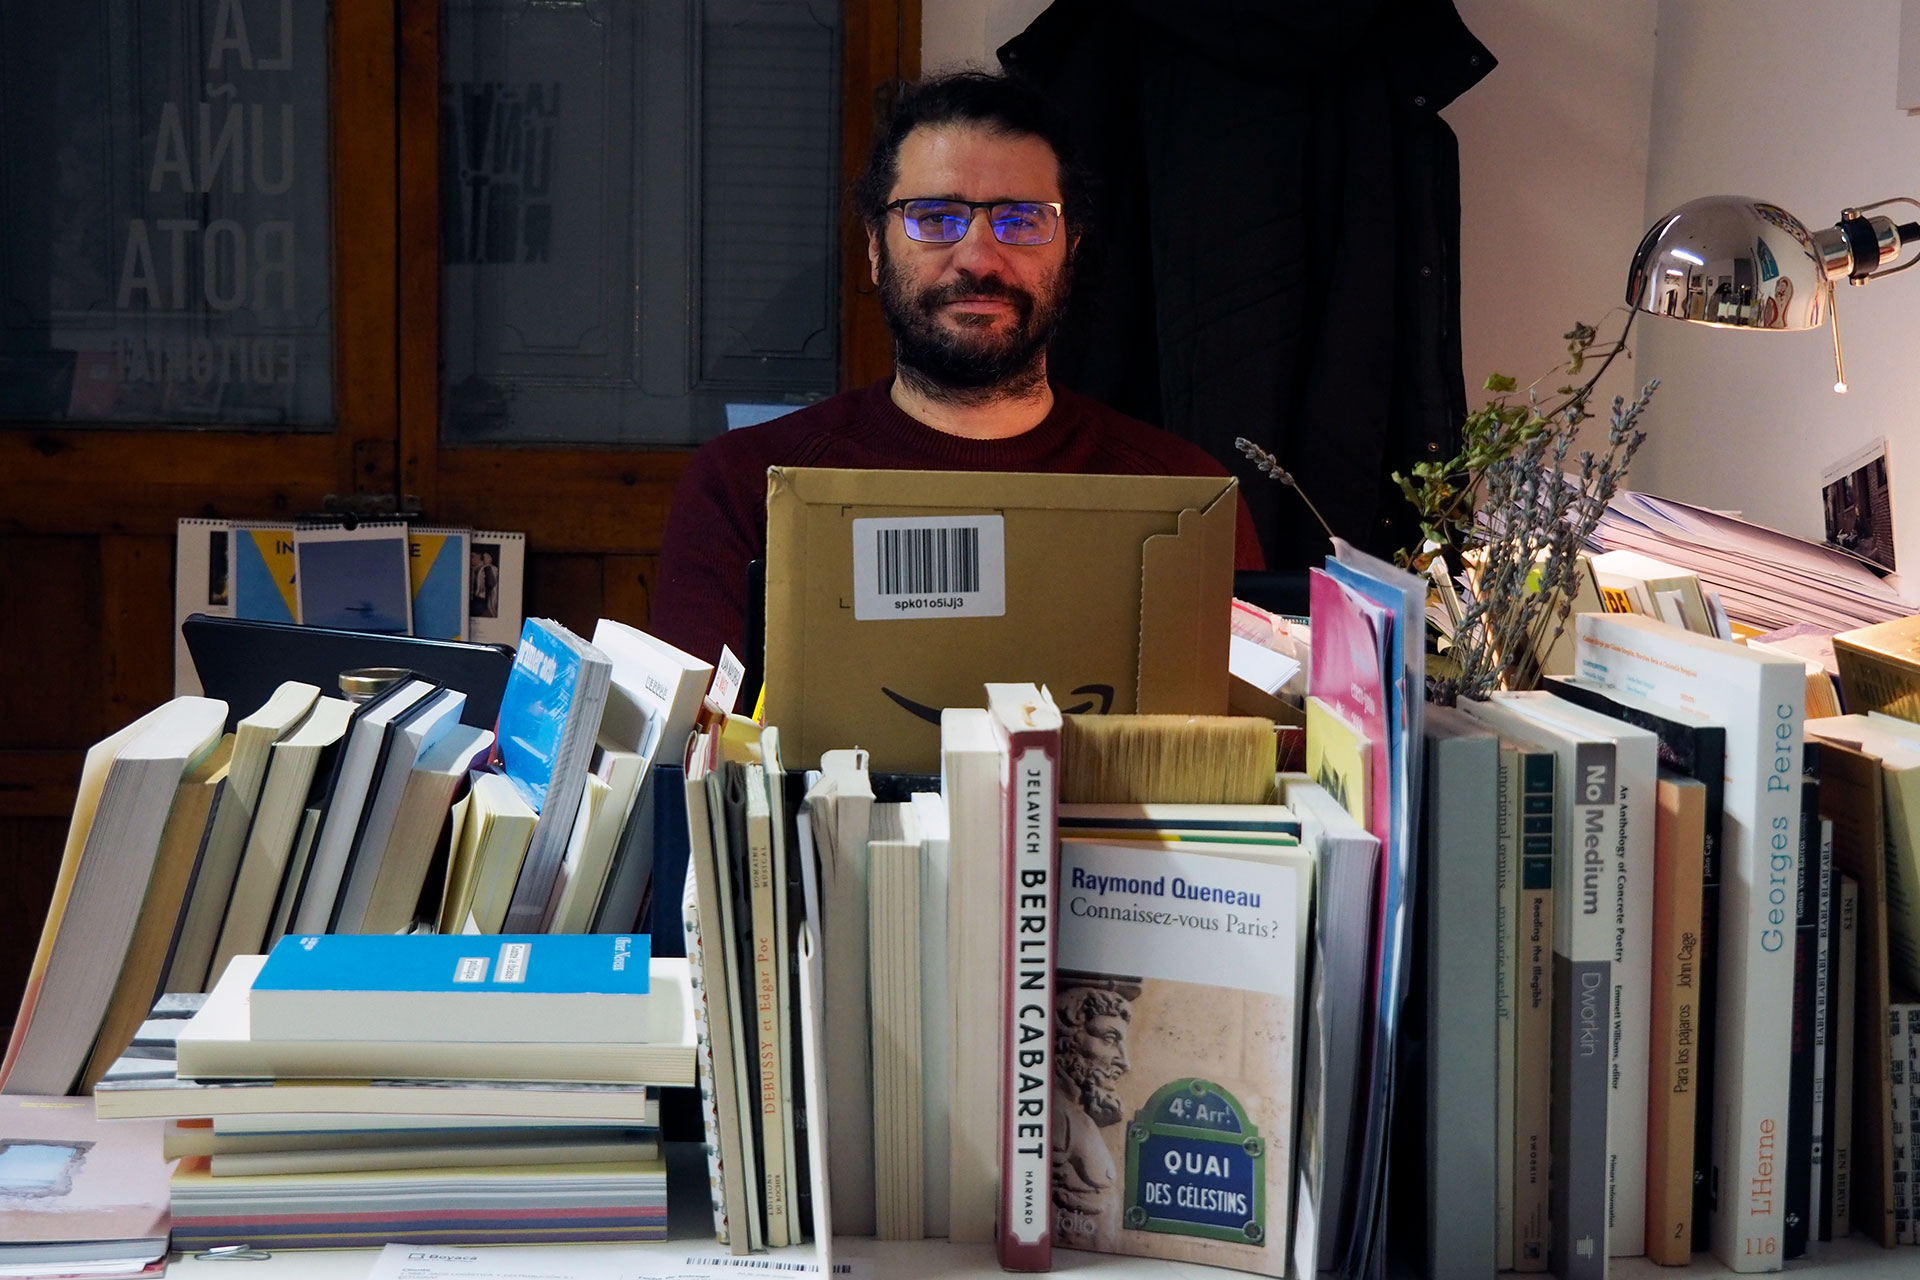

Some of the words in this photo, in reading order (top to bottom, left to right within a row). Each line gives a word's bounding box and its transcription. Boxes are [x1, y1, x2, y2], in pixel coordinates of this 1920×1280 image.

[1769, 703, 1793, 793] Perec
[1498, 765, 1511, 841] unoriginal
[1585, 765, 1606, 801] No
[1619, 785, 1629, 800] An
[1026, 769, 1041, 854] JELAVICH
[1615, 803, 1628, 859] Anthology
[1583, 809, 1605, 915] Medium
[1703, 834, 1714, 856] Cage
[751, 846, 761, 888] DOMAINE
[760, 845, 769, 888] MUSICAL
[1497, 844, 1509, 888] genius
[1618, 862, 1628, 873] of
[1703, 857, 1712, 878] John
[1761, 816, 1792, 953] Georges
[1821, 841, 1831, 897] BLABLABLA
[1072, 867, 1165, 898] Raymond
[1171, 875, 1261, 908] Queneau
[1616, 875, 1627, 924] Concrete
[1020, 870, 1047, 992] BERLIN
[1070, 898, 1221, 932] Connaissez-vous
[1531, 897, 1543, 942] Reading
[1819, 900, 1829, 939] BLABLA
[1843, 897, 1853, 930] NETS
[1497, 906, 1510, 967] marjorie
[1531, 945, 1542, 964] the
[1614, 927, 1626, 963] Poetry
[1677, 932, 1696, 961] Cage
[759, 969, 772, 1011] Edgar
[1497, 971, 1510, 1022] perloff
[1530, 965, 1543, 1009] Illegible
[1677, 963, 1693, 989] John
[1817, 949, 1827, 1005] BLABLABLA
[1579, 971, 1601, 1057] Dworkin
[1613, 984, 1623, 1019] Emmett
[762, 1014, 773, 1032] et
[1612, 1020, 1622, 1061] Williams,
[1815, 1007, 1825, 1046] BLABLA
[1674, 1037, 1689, 1059] los
[764, 1037, 776, 1114] DEBUSSY
[1018, 1003, 1045, 1160] CABARET
[1611, 1063, 1621, 1091] editor
[1674, 1061, 1690, 1094] Para
[1164, 1150, 1230, 1178] QUAI
[1529, 1135, 1538, 1184] DWORKIN
[1609, 1154, 1617, 1183] Primary
[1751, 1118, 1775, 1216] L'Herne
[1836, 1148, 1847, 1171] JEN
[1024, 1170, 1034, 1225] HARVARD
[1145, 1182, 1171, 1205] DES
[1177, 1183, 1248, 1215] CÉLESTINS
[1608, 1184, 1617, 1228] Information
[1836, 1173, 1847, 1217] BERVIN
[1056, 1208, 1096, 1234] folio
[1674, 1223, 1684, 1239] 2
[1745, 1236, 1776, 1256] 116
